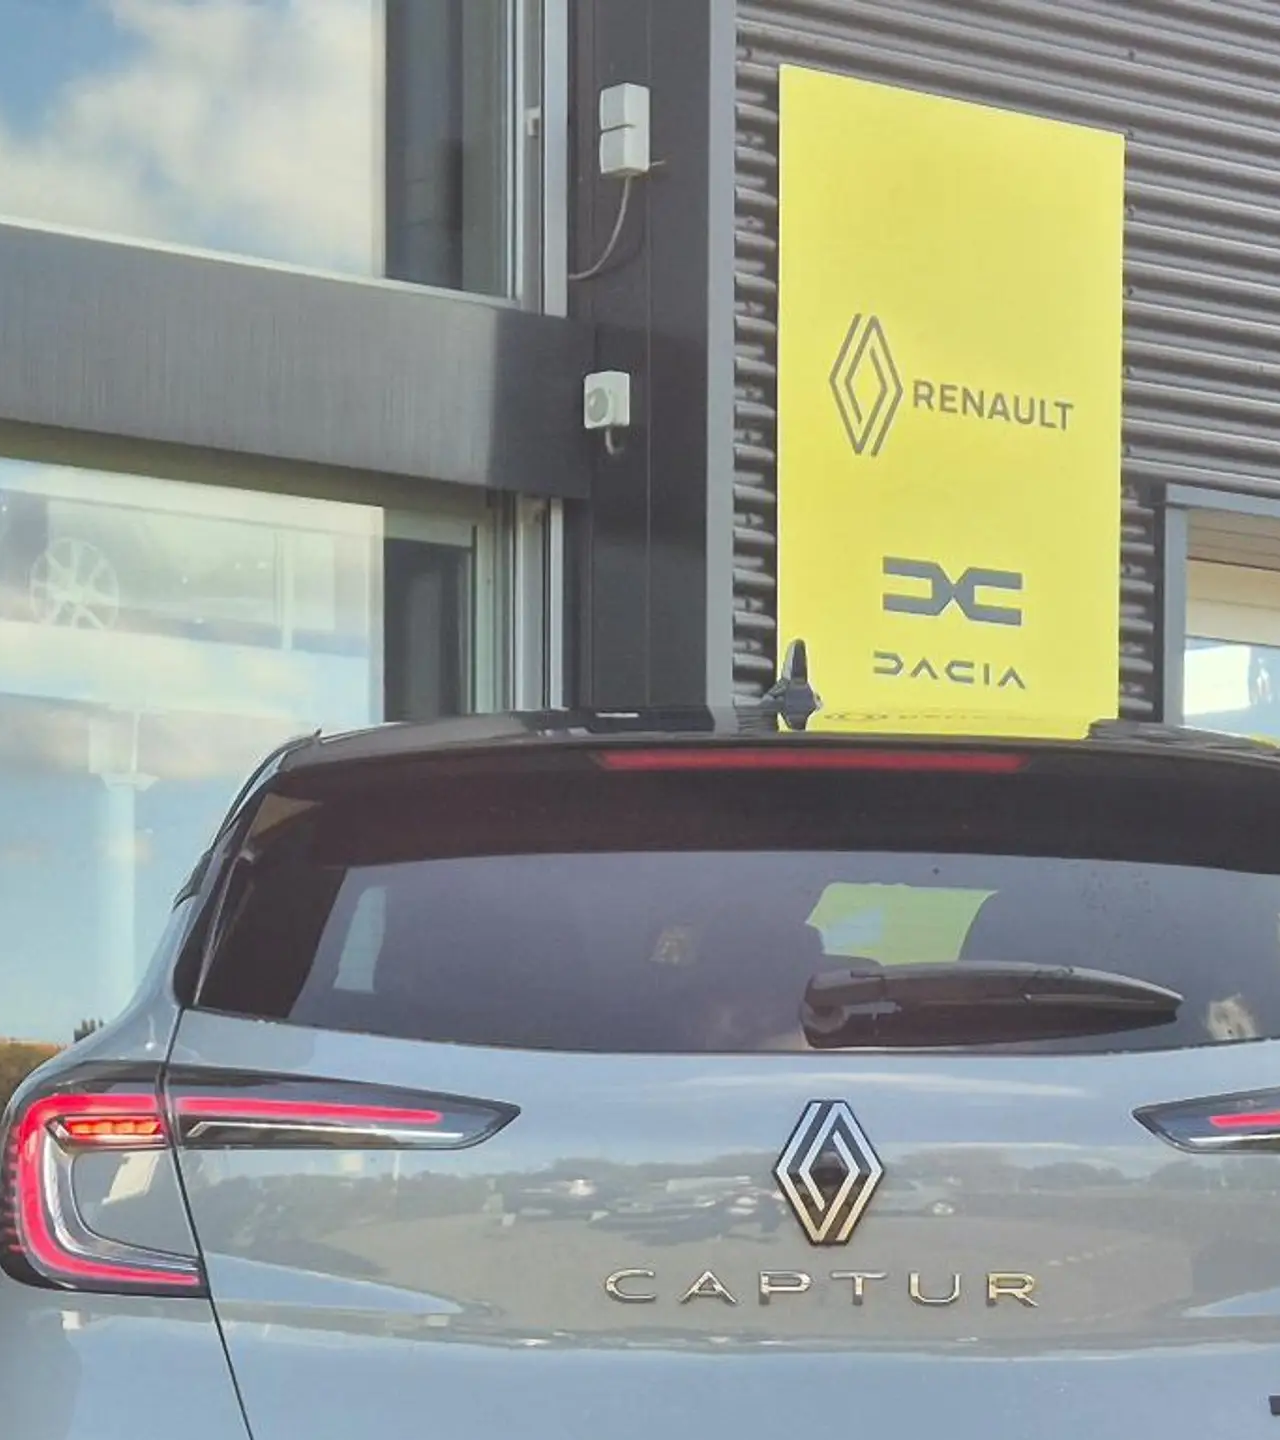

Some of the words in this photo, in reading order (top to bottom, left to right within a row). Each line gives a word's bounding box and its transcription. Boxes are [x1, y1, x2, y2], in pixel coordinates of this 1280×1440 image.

[914, 379, 1074, 431] RENAULT
[872, 651, 1026, 690] DACIA
[604, 1268, 1039, 1307] CAPTUR
